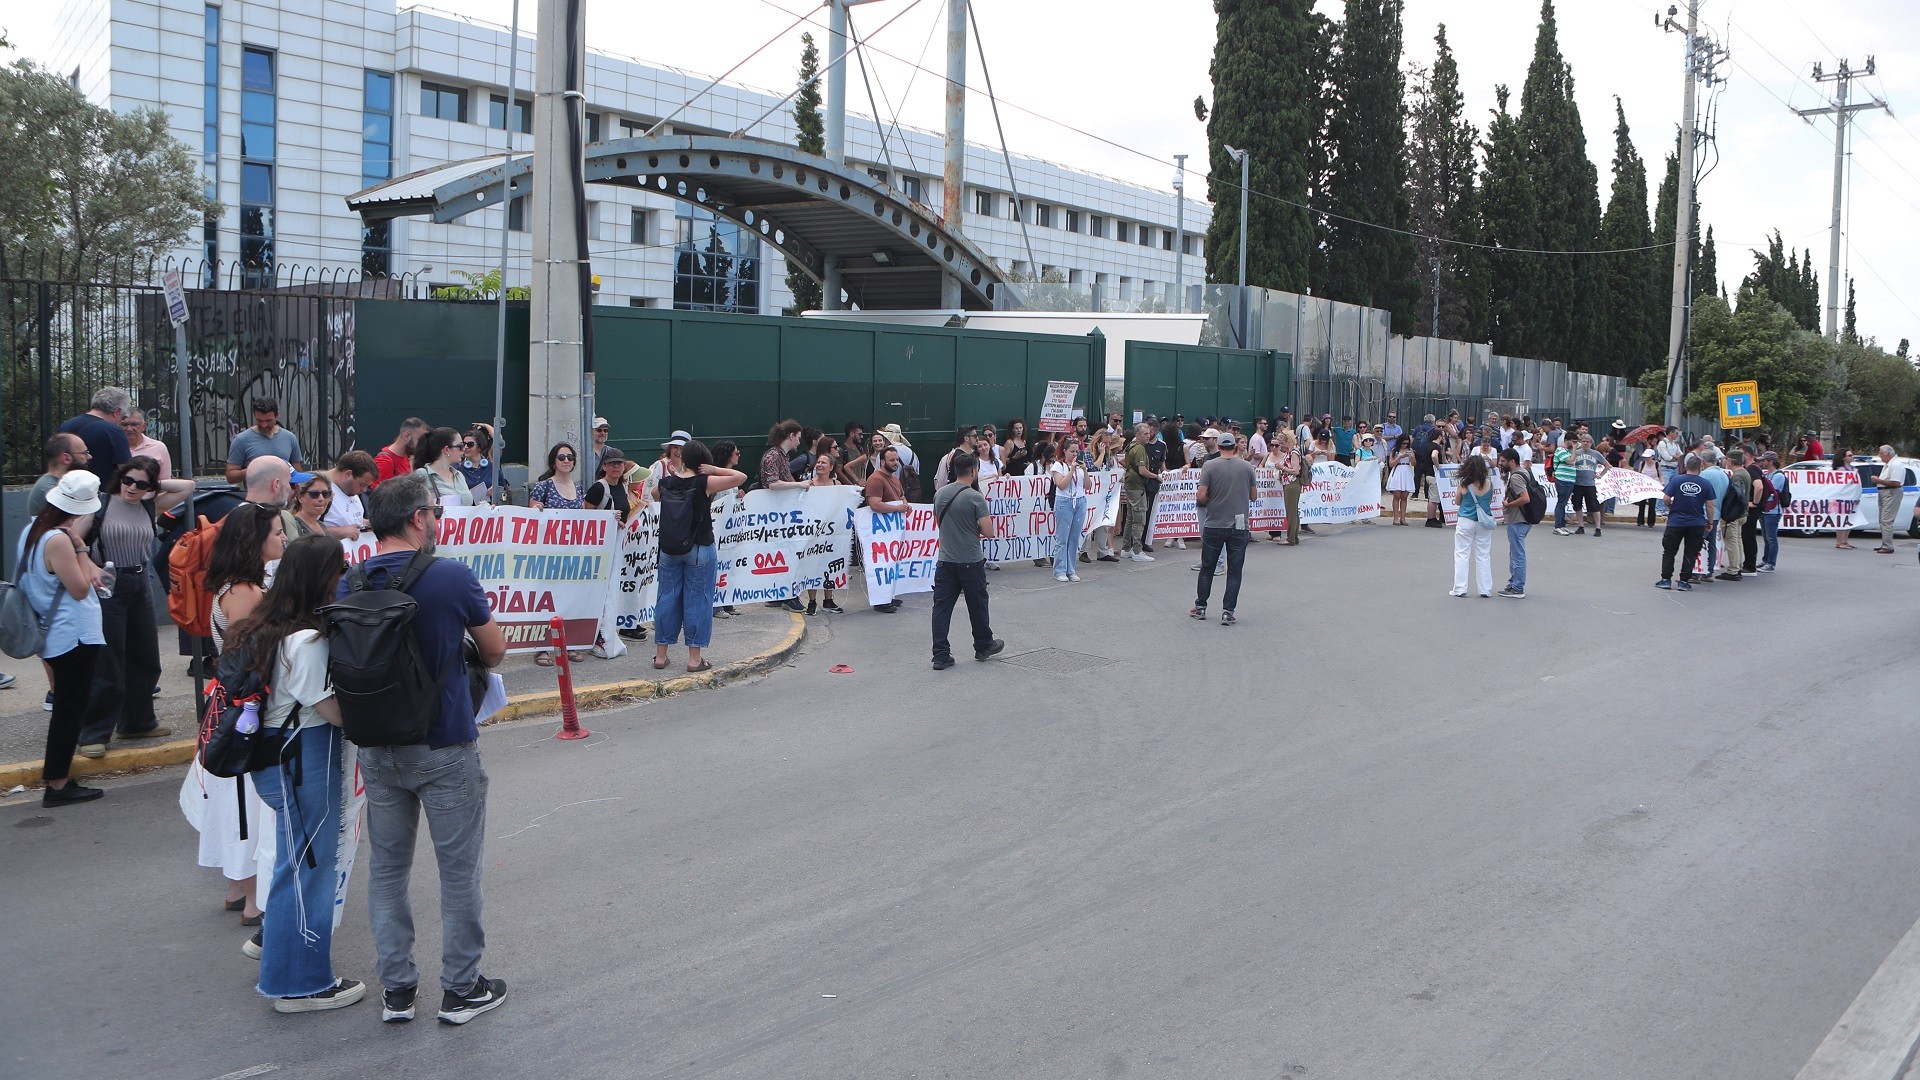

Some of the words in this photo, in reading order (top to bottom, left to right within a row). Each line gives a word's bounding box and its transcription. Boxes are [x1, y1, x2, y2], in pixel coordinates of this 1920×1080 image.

[985, 480, 1022, 500] ΣΤΗΝ
[1180, 482, 1194, 490] ΑΠΟ
[1783, 515, 1853, 527] ΠΕΙΡΑΙΑ
[469, 517, 504, 544] ΟΛΑ
[512, 517, 539, 544] ΤΑ
[543, 519, 606, 546] ΚΕΝΑ!
[1005, 536, 1032, 560] ΣΤΟΥΣ
[471, 554, 506, 580] ΑΝΑ
[514, 555, 602, 581] ΤΜΗΜΑ!
[754, 551, 786, 569] ΟΛΑ
